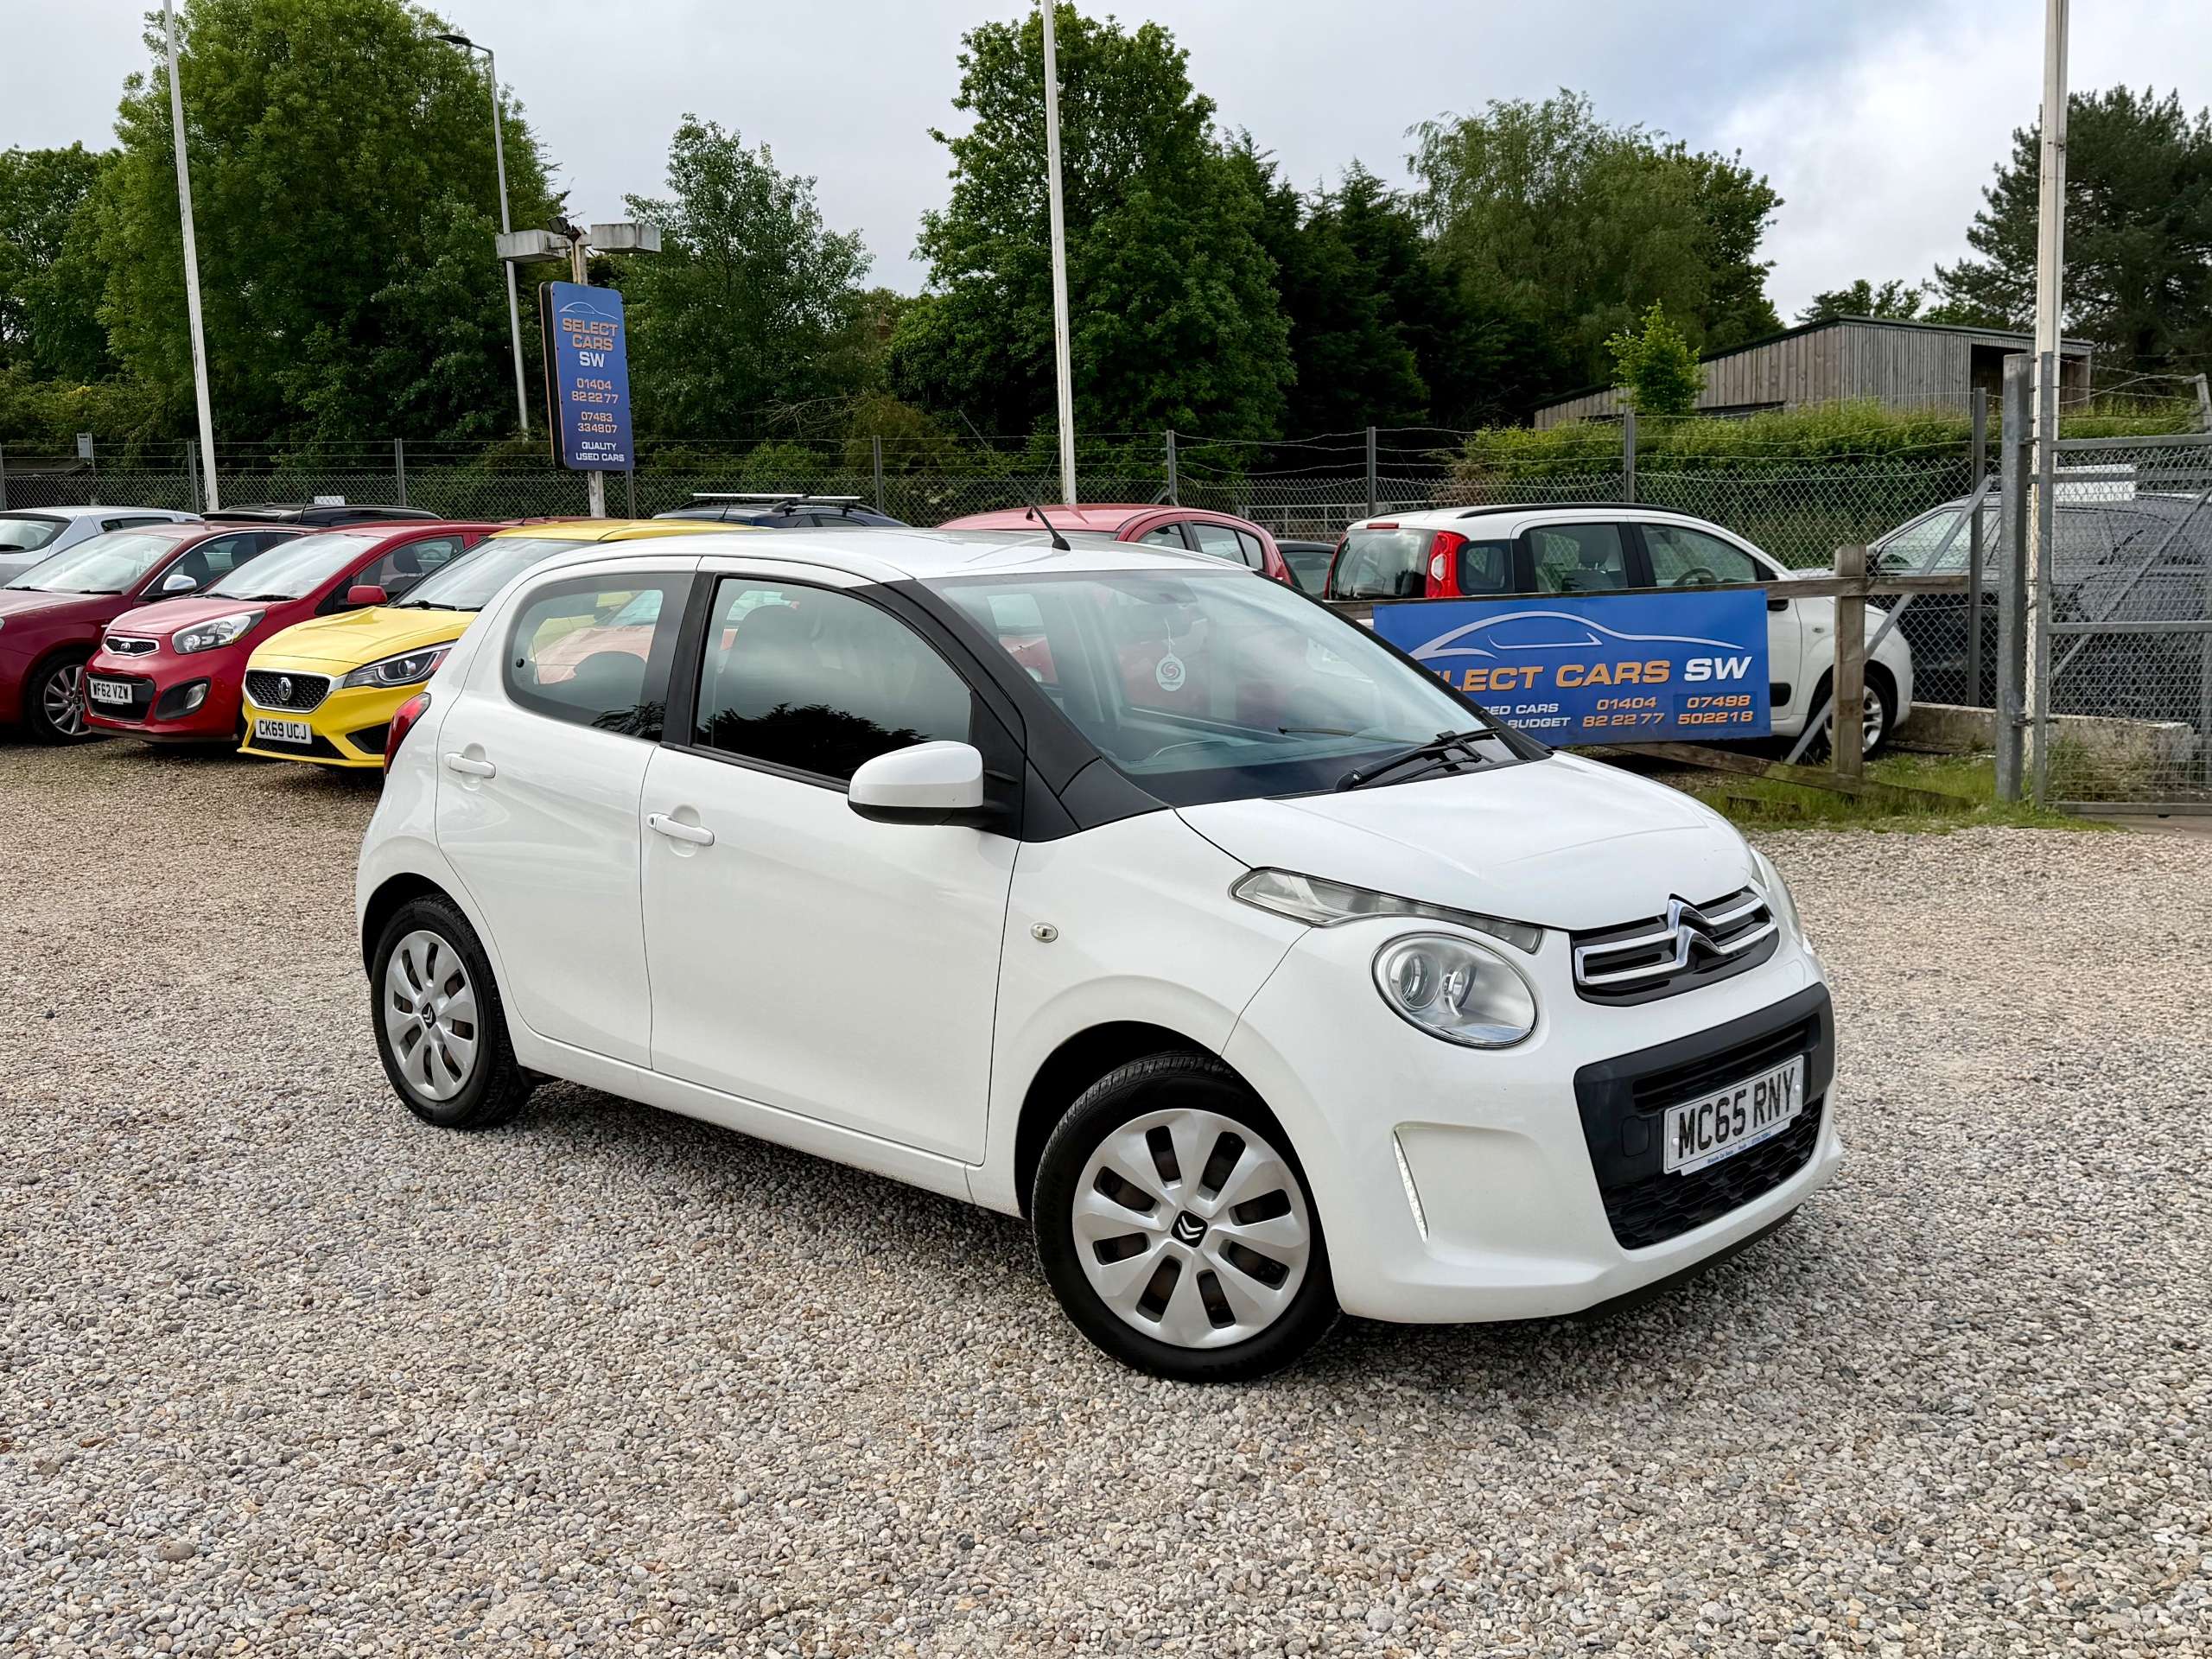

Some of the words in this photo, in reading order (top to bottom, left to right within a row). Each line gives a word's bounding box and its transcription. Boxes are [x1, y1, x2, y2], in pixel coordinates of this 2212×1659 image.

[563, 317, 619, 337] SELECT
[572, 334, 613, 352] CARS
[579, 351, 605, 368] SW
[576, 377, 612, 391] 01404
[581, 411, 613, 423] 07483
[582, 441, 617, 451] QUALITY
[575, 452, 600, 461] USED
[601, 453, 625, 462] CARS
[1433, 666, 1544, 691] ECT
[1555, 660, 1671, 688] CARS
[1684, 656, 1753, 682] SW
[1515, 703, 1559, 715] CARS
[1596, 696, 1657, 710] 01404
[1686, 695, 1751, 709] 07498
[1507, 717, 1572, 729] BUDGET
[1677, 710, 1754, 725] 502218
[259, 720, 284, 738] CK69
[286, 722, 307, 741] UCJ
[1678, 1088, 1747, 1160] MC65
[1752, 1066, 1796, 1129] RNY
